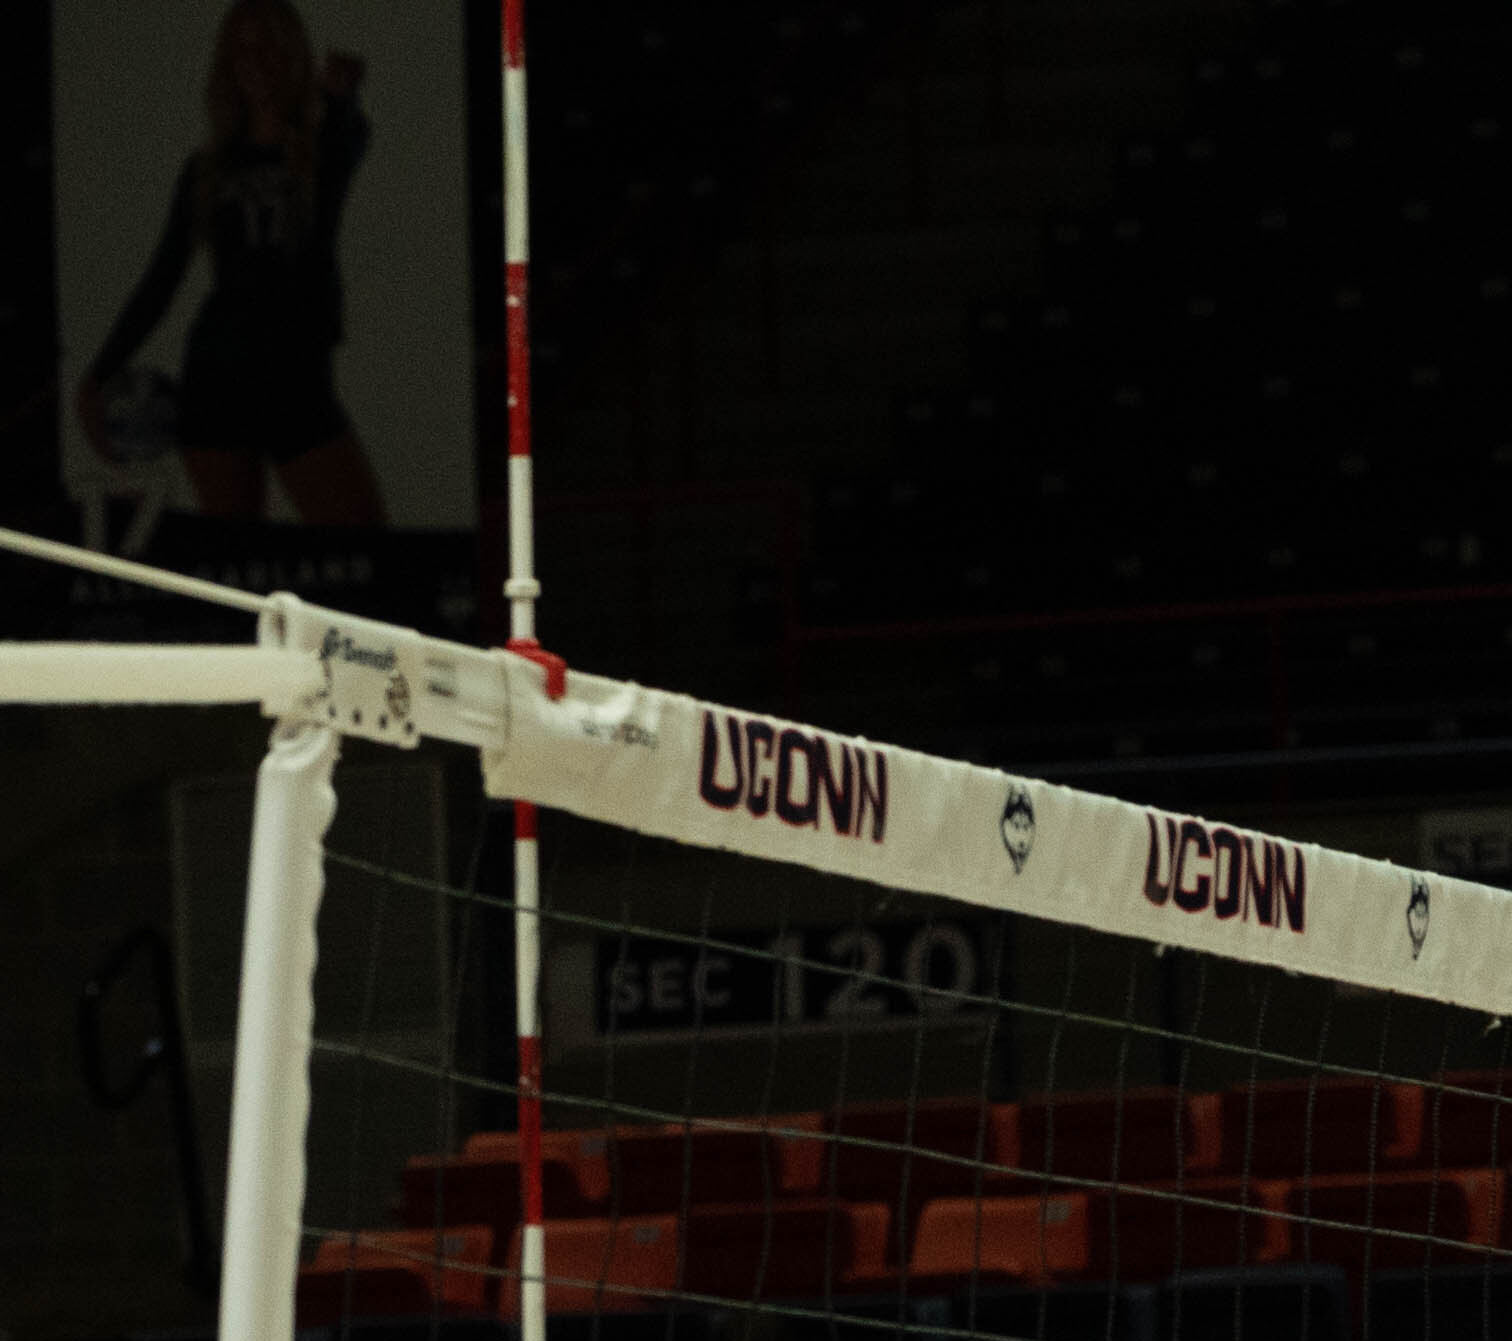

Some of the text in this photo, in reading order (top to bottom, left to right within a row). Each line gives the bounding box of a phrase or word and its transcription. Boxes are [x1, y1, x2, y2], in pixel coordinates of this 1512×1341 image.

[699, 709, 888, 845] UCONN
[1143, 812, 1305, 934] UCONN
[606, 919, 979, 1019] SEC 120
